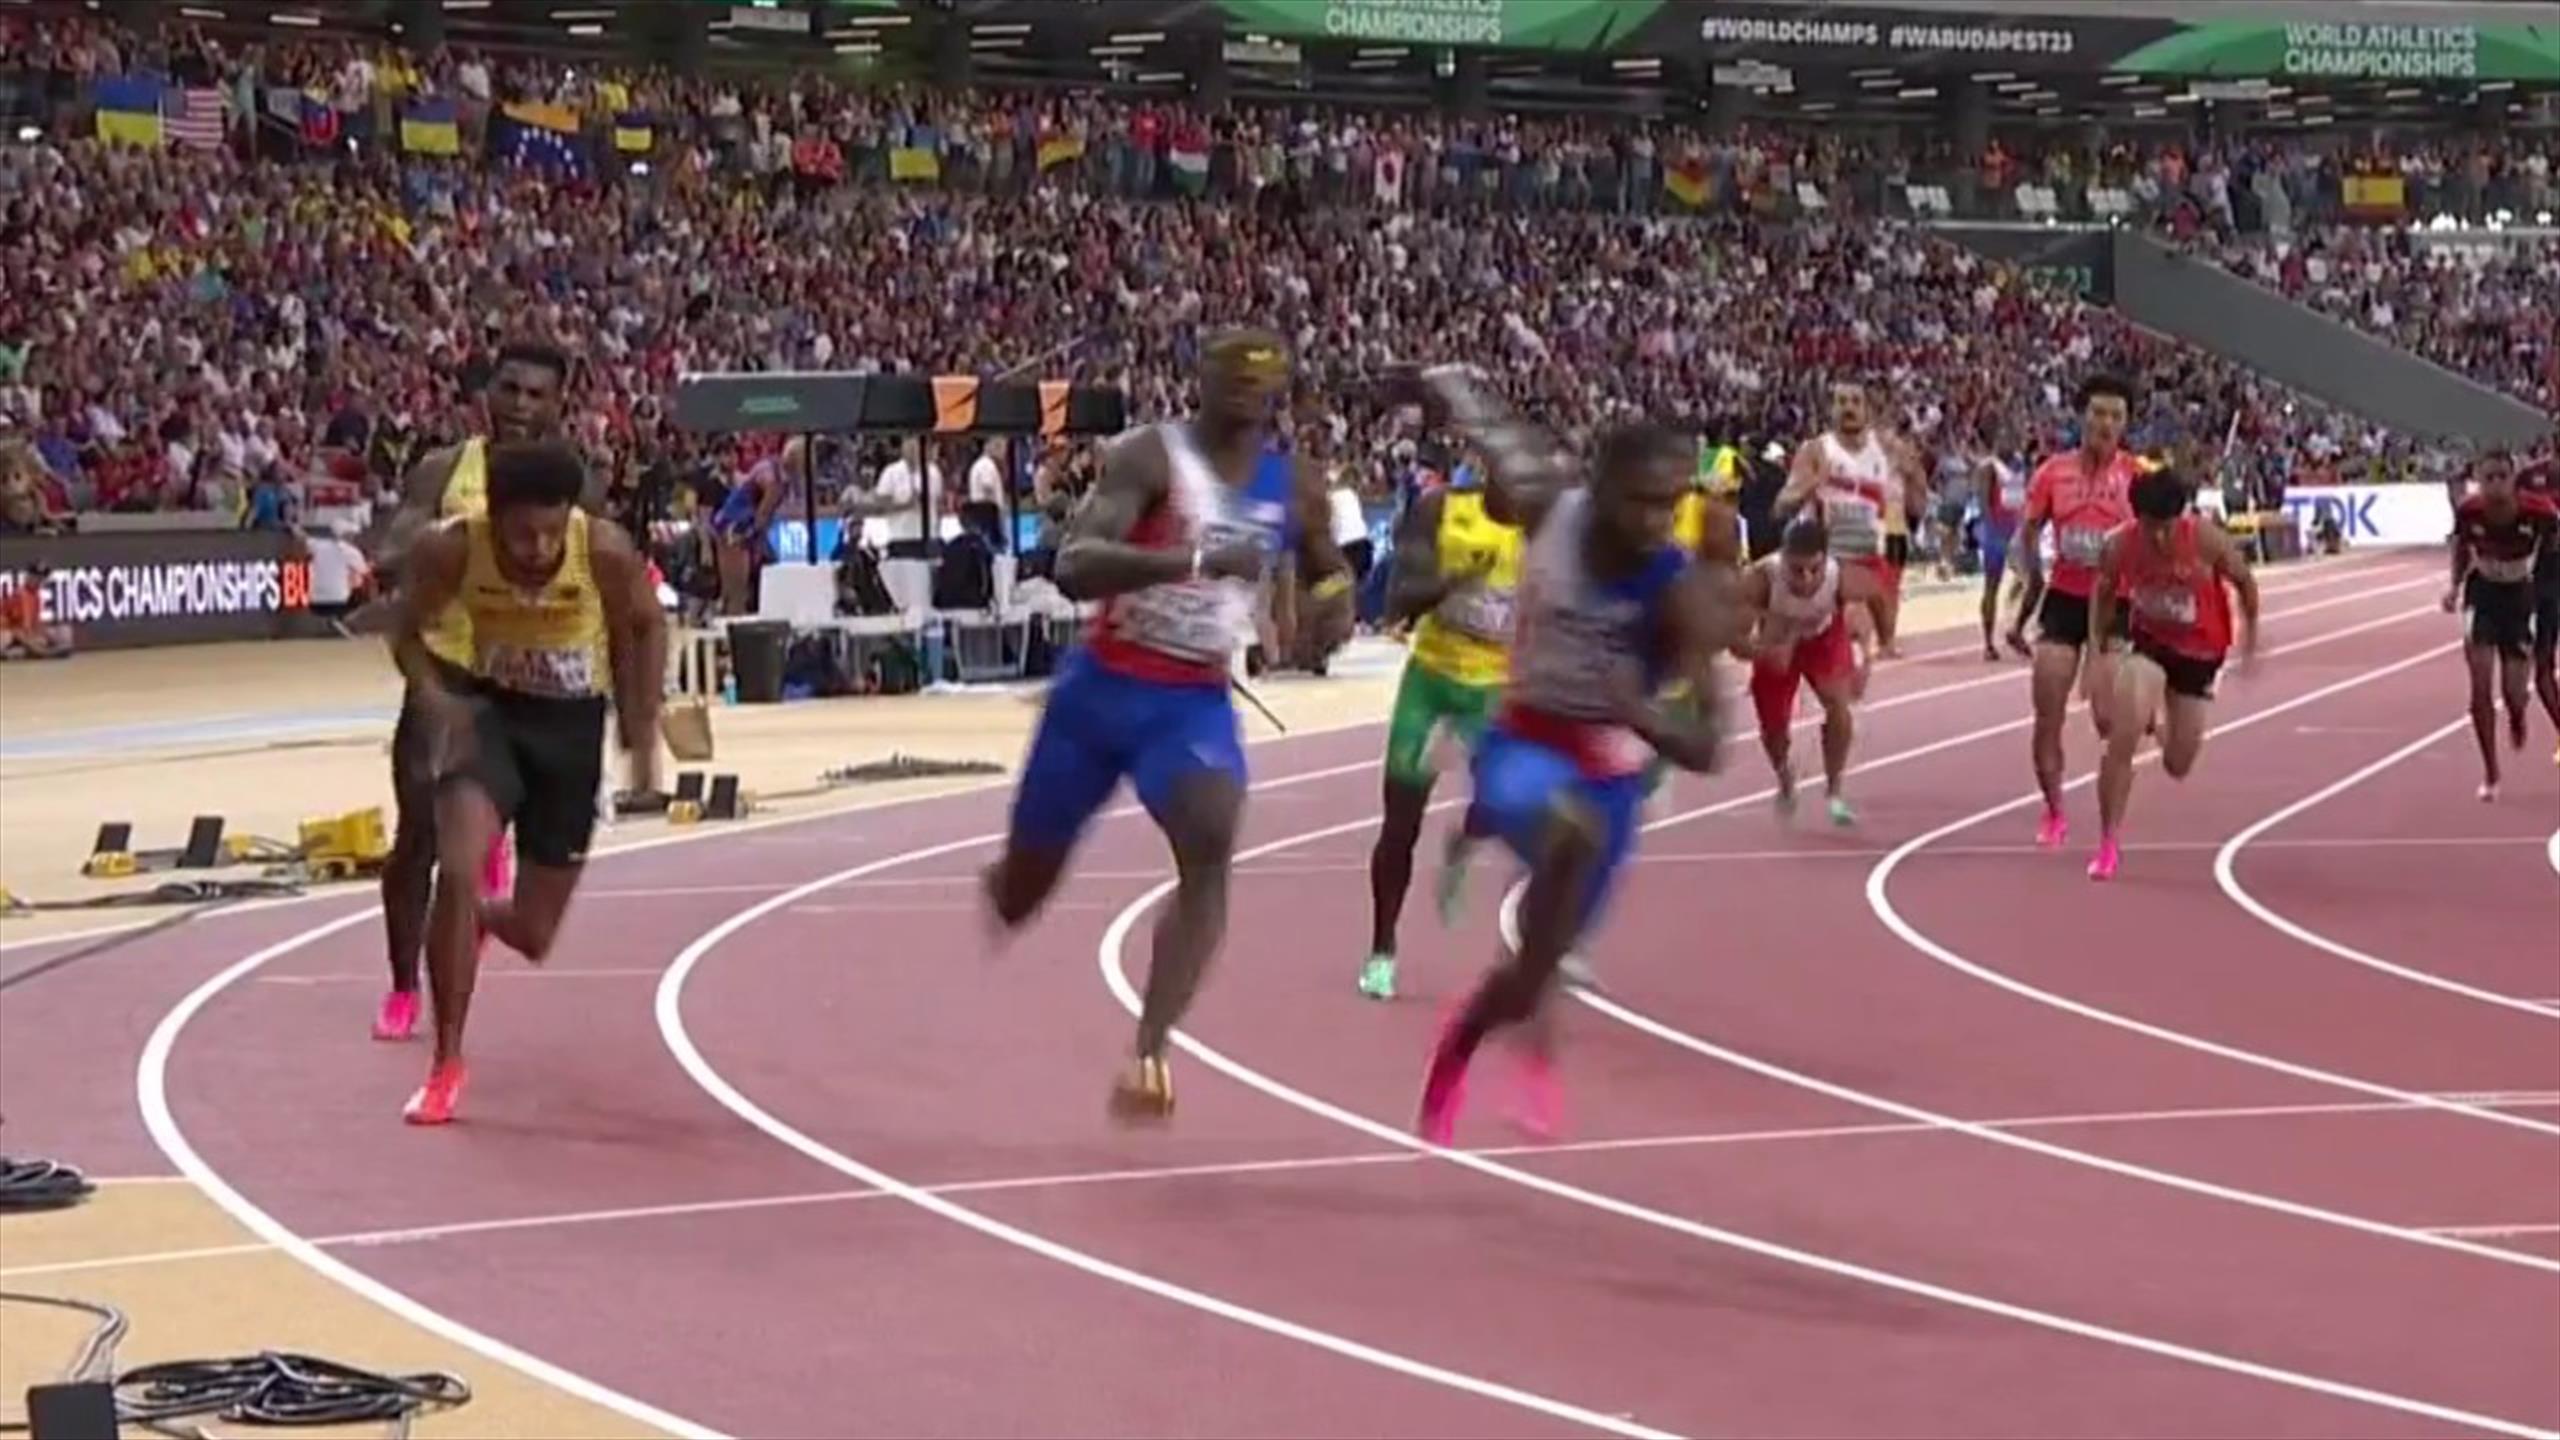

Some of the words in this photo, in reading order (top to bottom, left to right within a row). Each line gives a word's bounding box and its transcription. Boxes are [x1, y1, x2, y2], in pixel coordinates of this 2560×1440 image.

[1325, 8, 1501, 43] CHAMPIONSHIPS
[1702, 18, 1878, 45] #WORLDCHAMPS
[1890, 25, 2073, 52] #WABUDAPEST23
[2285, 22, 2361, 47] WORLD
[2366, 24, 2477, 49] ATHLETICS
[2284, 49, 2477, 77] CHAMPIONSHIPS
[106, 559, 281, 618] CHAMPIONSHIPS
